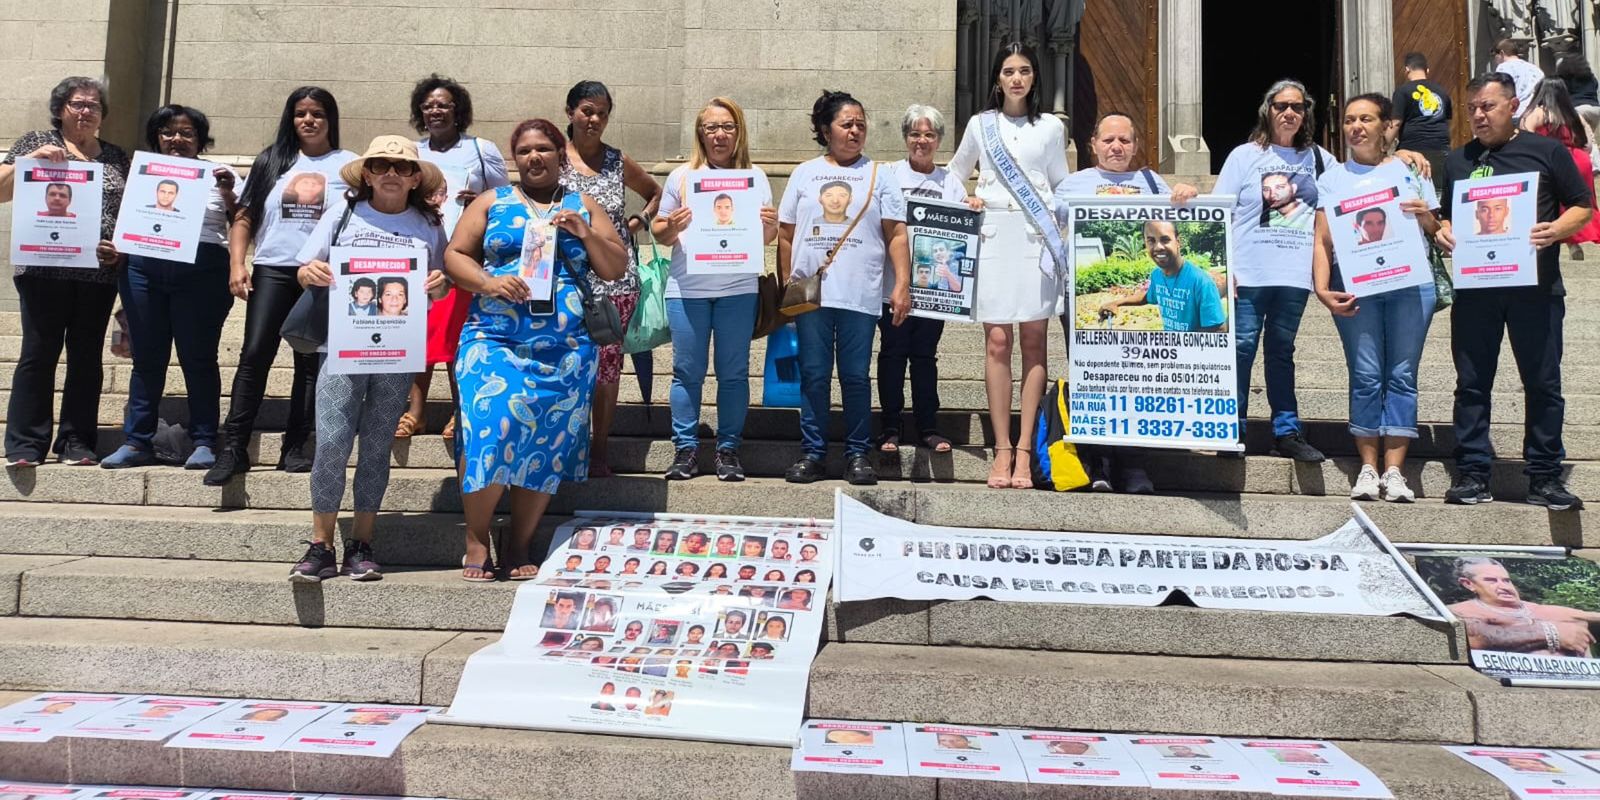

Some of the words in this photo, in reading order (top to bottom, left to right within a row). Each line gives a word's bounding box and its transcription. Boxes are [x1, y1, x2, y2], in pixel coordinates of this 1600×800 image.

[36, 170, 84, 180] DESAPARECIDO
[989, 139, 1019, 183] UNIVERSE
[1016, 185, 1043, 217] BRASIL
[1472, 186, 1518, 197] DESAPARECIDO
[1344, 192, 1390, 209] DESAPARECIDO
[926, 212, 949, 223] MÃES
[950, 216, 962, 225] DA
[963, 216, 974, 227] SÉ
[1075, 207, 1225, 222] DESAPARECIDO
[913, 226, 969, 240] DESAPARECIDO
[353, 260, 407, 270] DESAPARECIDO
[1075, 331, 1119, 345] WELLERSON
[1120, 331, 1148, 346] JUNIOR
[1150, 333, 1182, 347] PEREIRA
[1183, 333, 1229, 351] GONÇALVES
[1121, 346, 1141, 360] 39
[1142, 348, 1178, 360] ANOS
[1074, 360, 1086, 368] Não
[1086, 360, 1120, 369] dependente
[1147, 361, 1160, 369] sem
[1160, 361, 1192, 371] problemas
[1083, 371, 1140, 383] Desapareceu
[1142, 374, 1153, 383] no
[1155, 372, 1169, 383] dia
[1171, 372, 1220, 384] 05/01/2014
[1076, 383, 1088, 392] Caso
[1119, 385, 1128, 394] por
[1163, 386, 1181, 395] contato
[1191, 386, 1214, 396] telefones
[1072, 401, 1085, 411] NA
[1087, 401, 1107, 412] RUA
[1109, 394, 1127, 412] 11
[1134, 395, 1237, 415] 98261-1208
[1072, 413, 1107, 425] MÃES
[1072, 426, 1087, 435] DA
[1109, 418, 1129, 435] 11
[1137, 419, 1238, 440] 3337-3331
[902, 541, 1039, 564] PERDIDOS:
[1044, 545, 1115, 568] SEJA
[1119, 548, 1208, 570] PARTE
[1213, 550, 1251, 571] DA
[1255, 552, 1349, 571] NOSSA
[916, 571, 1008, 590] CAUSA
[1012, 577, 1098, 593] PELOS
[1481, 651, 1533, 671] BENÍCIO
[1533, 657, 1591, 675] MARIANO
